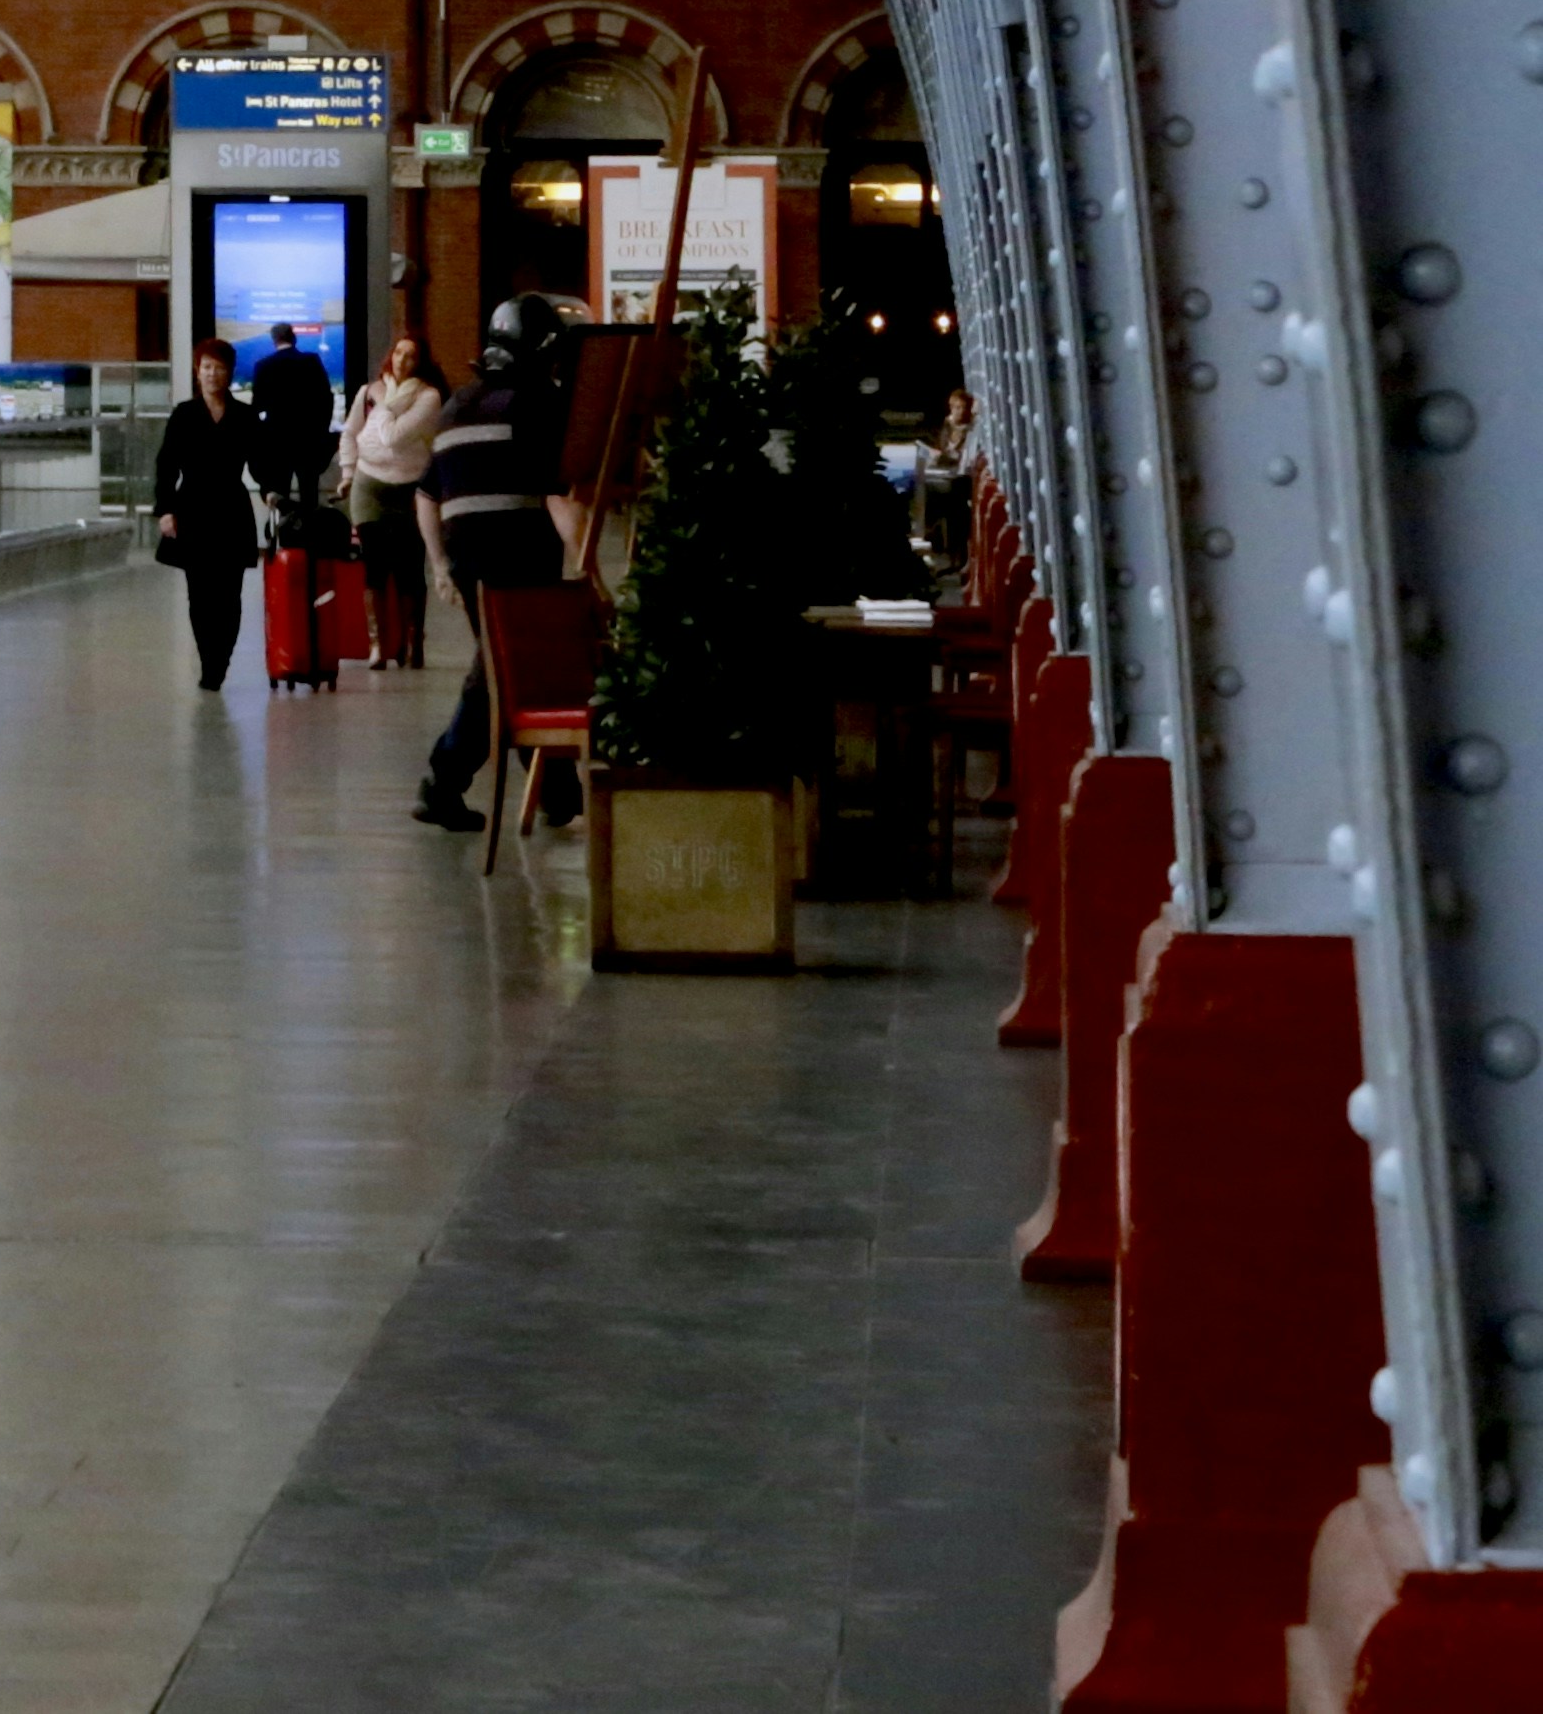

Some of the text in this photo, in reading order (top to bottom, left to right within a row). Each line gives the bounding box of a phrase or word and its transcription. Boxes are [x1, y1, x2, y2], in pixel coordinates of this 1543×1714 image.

[196, 59, 215, 73] All
[215, 59, 248, 72] other
[250, 59, 286, 72] trains
[336, 76, 363, 90] Lifts
[265, 96, 363, 109] St Pancras Hotel
[315, 115, 340, 129] Way
[343, 115, 363, 126] out
[619, 219, 750, 238] BREKFAST
[617, 243, 750, 258] OF CMPIONS
